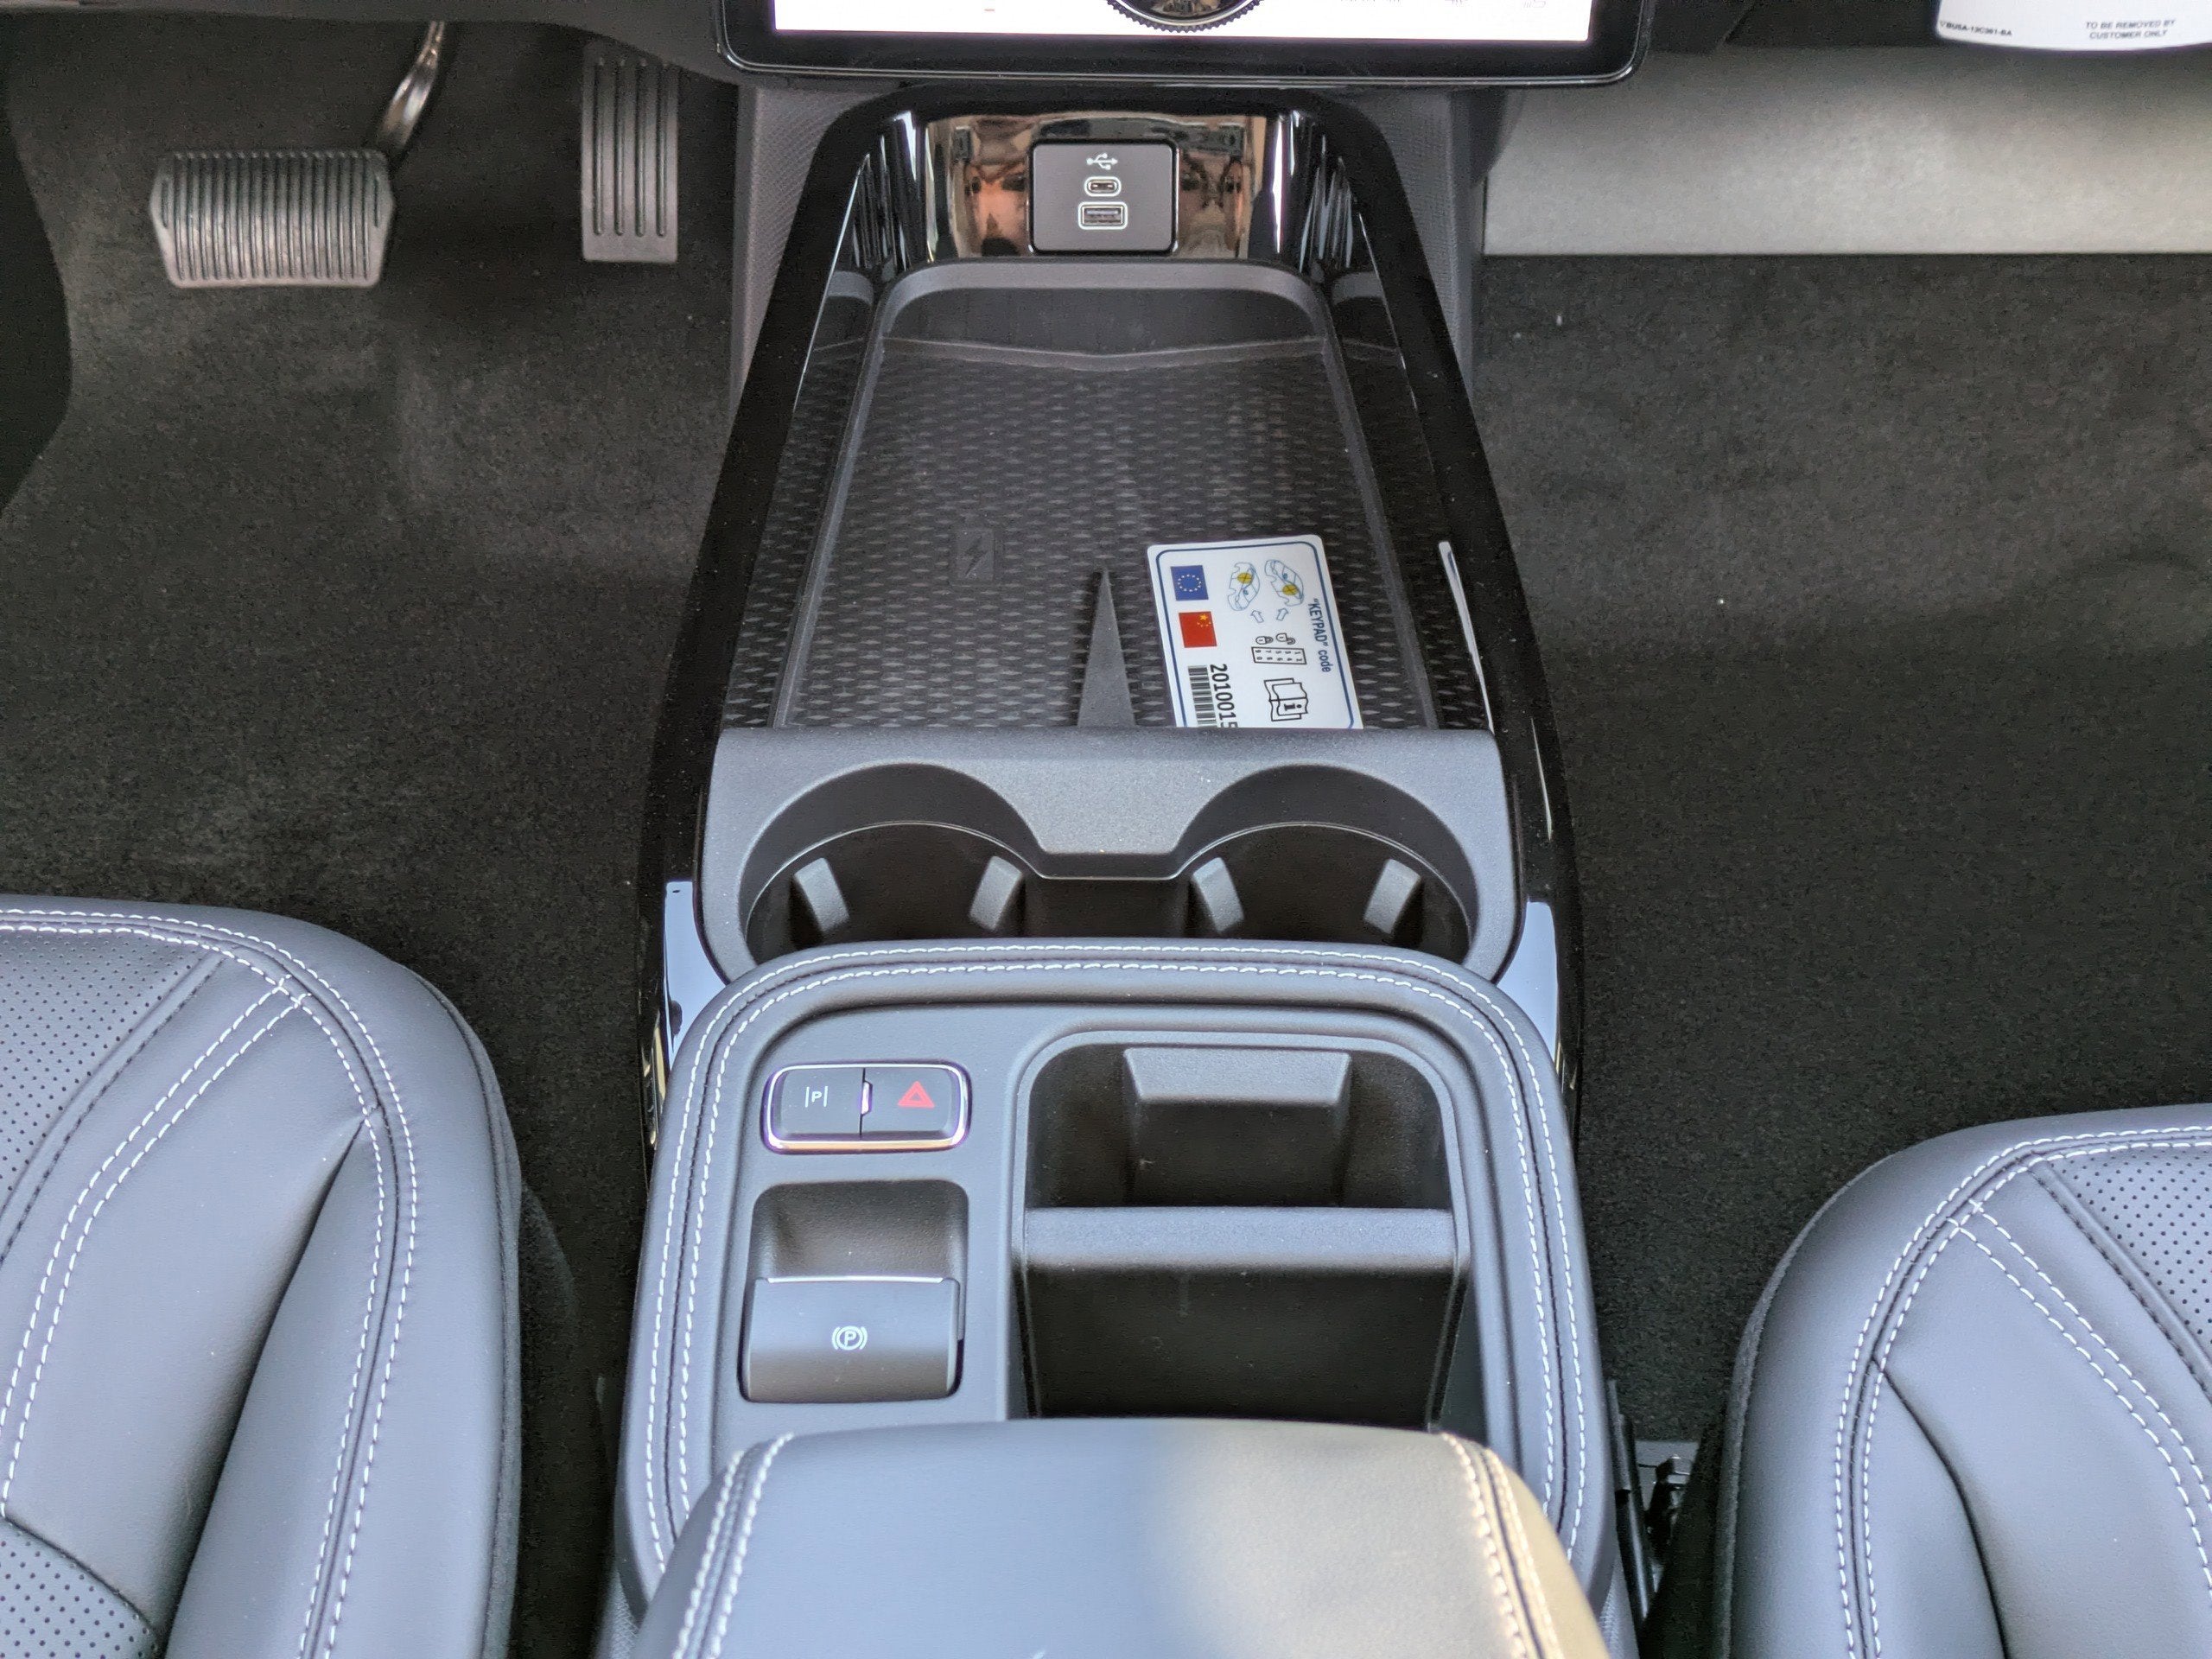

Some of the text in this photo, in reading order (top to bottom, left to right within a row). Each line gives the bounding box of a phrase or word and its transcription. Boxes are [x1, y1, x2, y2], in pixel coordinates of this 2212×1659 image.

[2085, 18, 2176, 29] TO BE REMOVED BY
[2089, 29, 2168, 40] CUSTOMER ONLY
[1318, 649, 1334, 672] code
